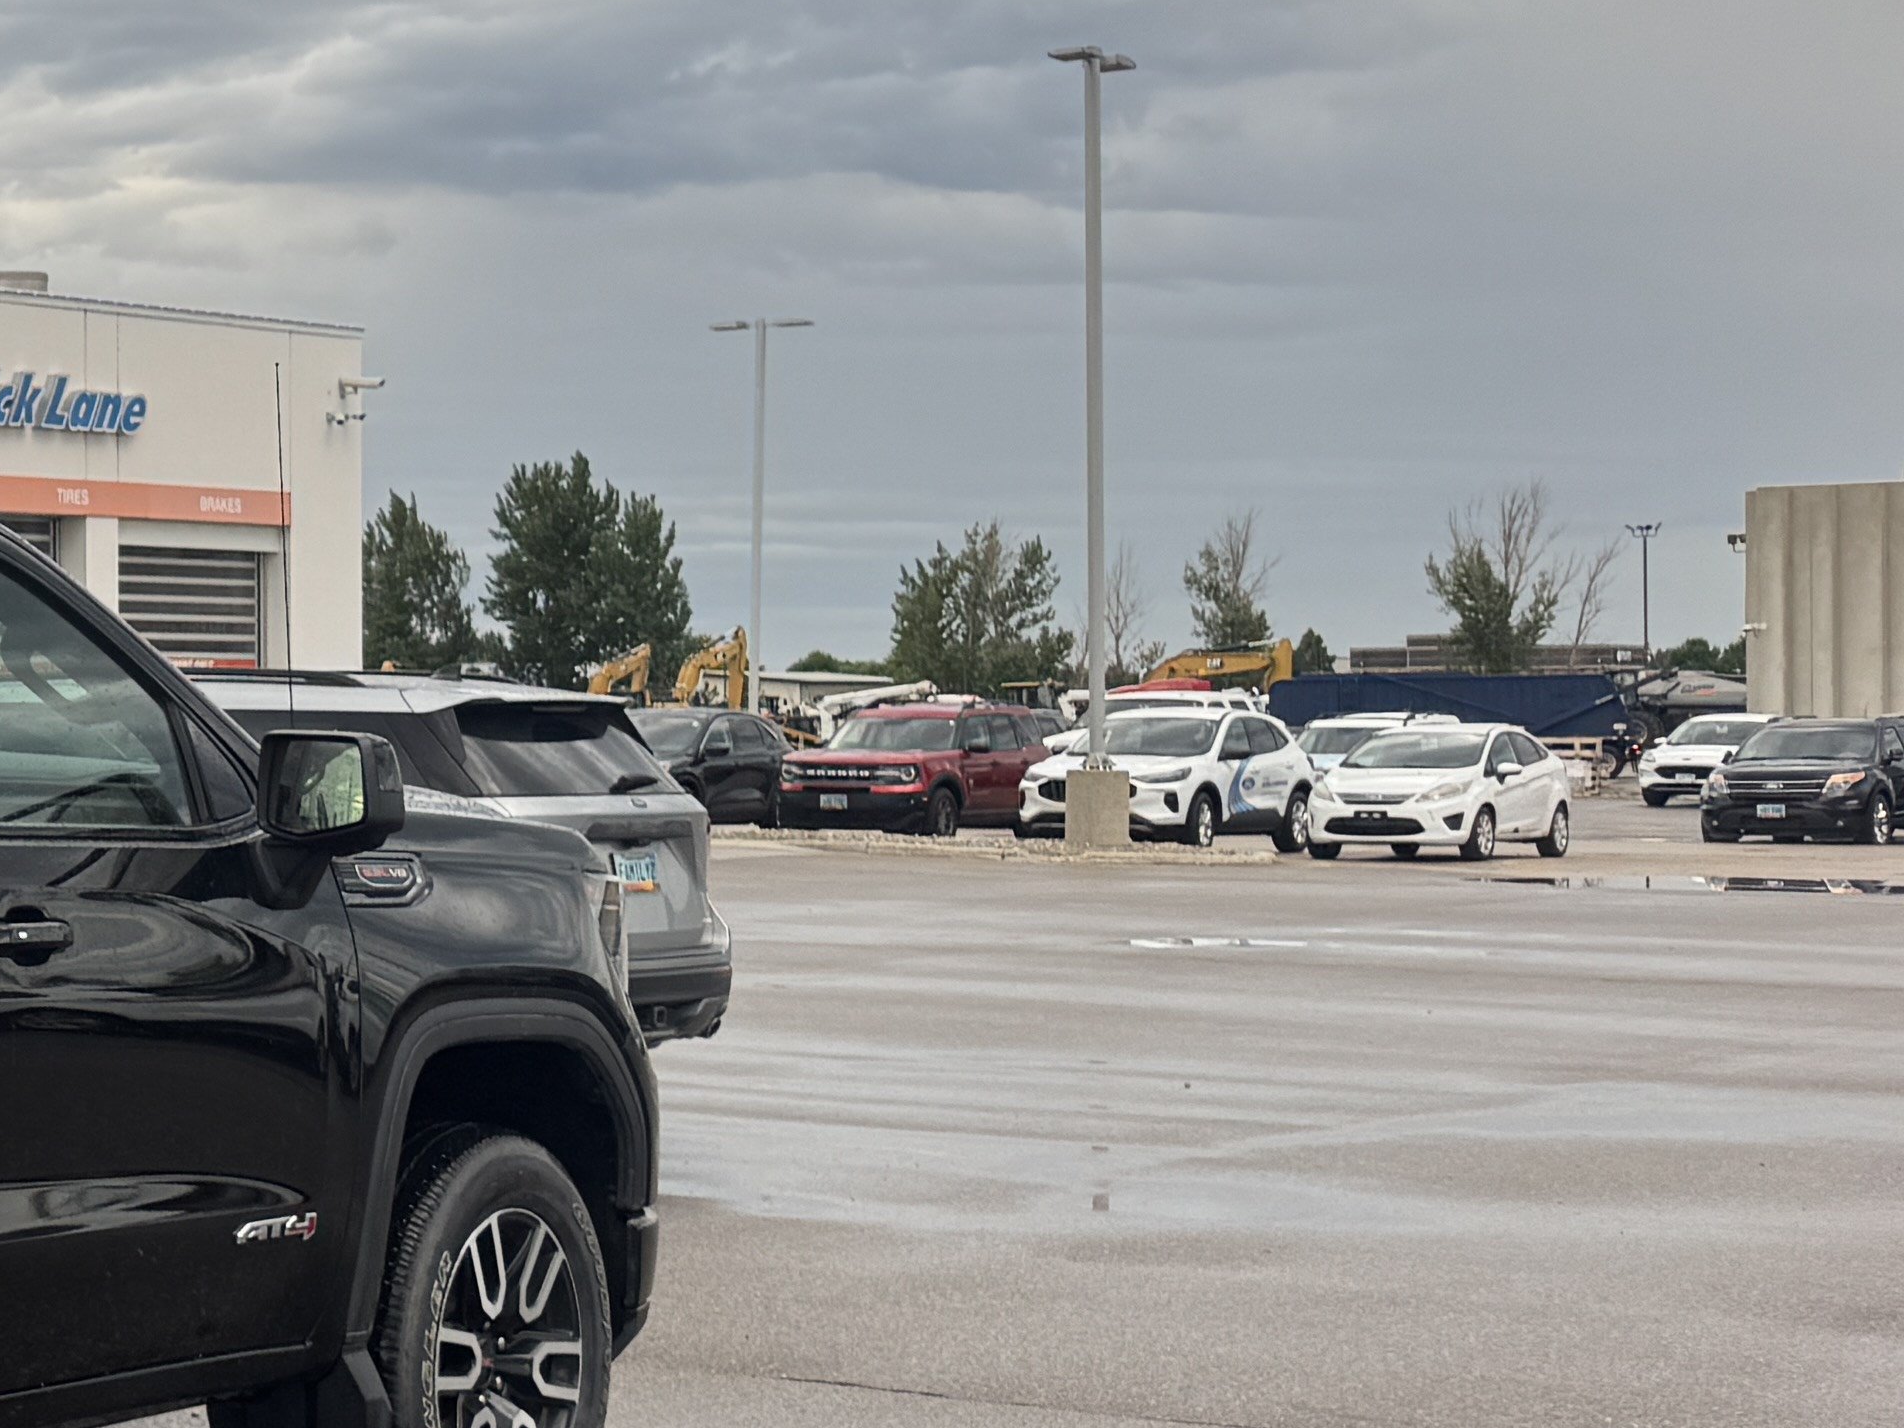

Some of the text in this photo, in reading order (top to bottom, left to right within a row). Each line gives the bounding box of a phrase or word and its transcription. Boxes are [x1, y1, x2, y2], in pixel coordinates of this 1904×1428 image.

[44, 373, 148, 436] Lane
[56, 487, 90, 507] TIRES
[199, 495, 243, 515] BRAKES
[232, 1211, 318, 1245] AT4
